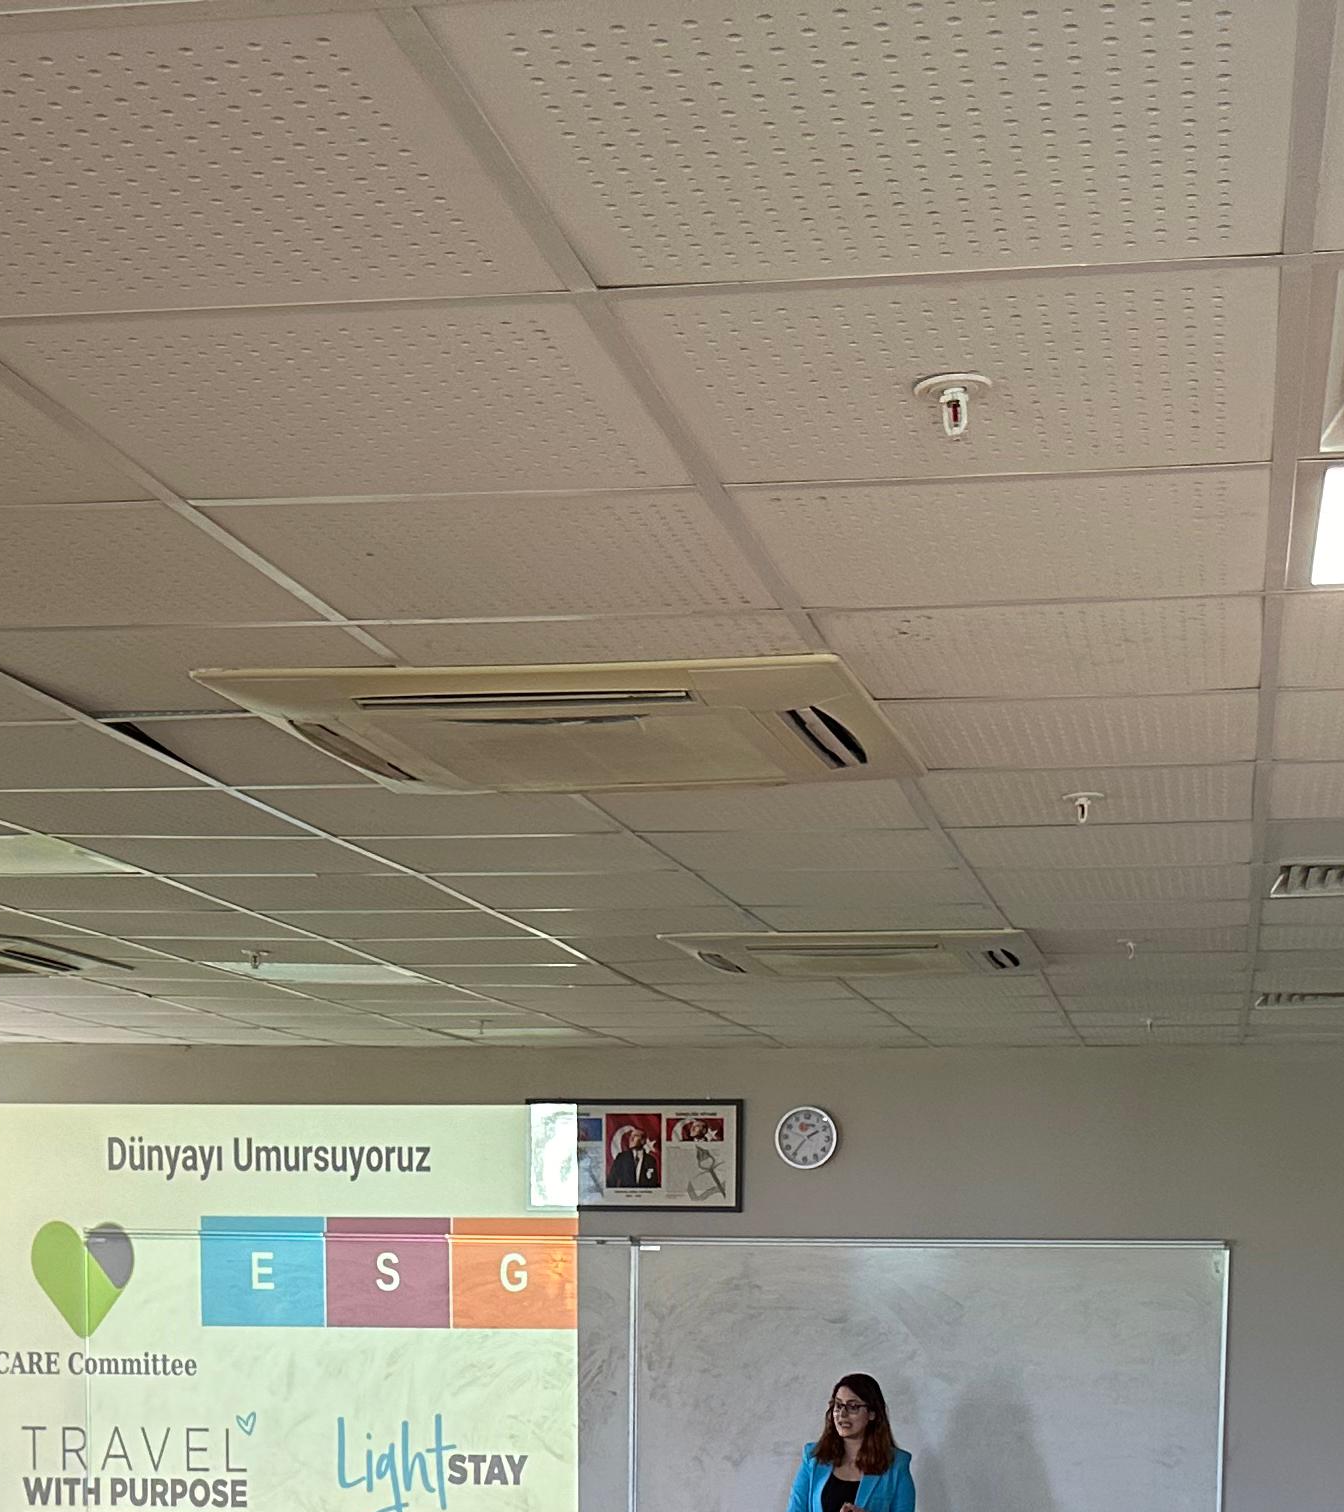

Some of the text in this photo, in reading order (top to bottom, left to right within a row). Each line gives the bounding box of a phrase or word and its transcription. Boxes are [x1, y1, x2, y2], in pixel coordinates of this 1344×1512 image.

[107, 1136, 431, 1182] Dünyayı Umursuyoruz
[251, 1251, 528, 1292] E S G
[68, 1351, 198, 1376] Committee
[21, 1426, 248, 1472] TRAVEL
[22, 1477, 248, 1508] WITH PURPOSE
